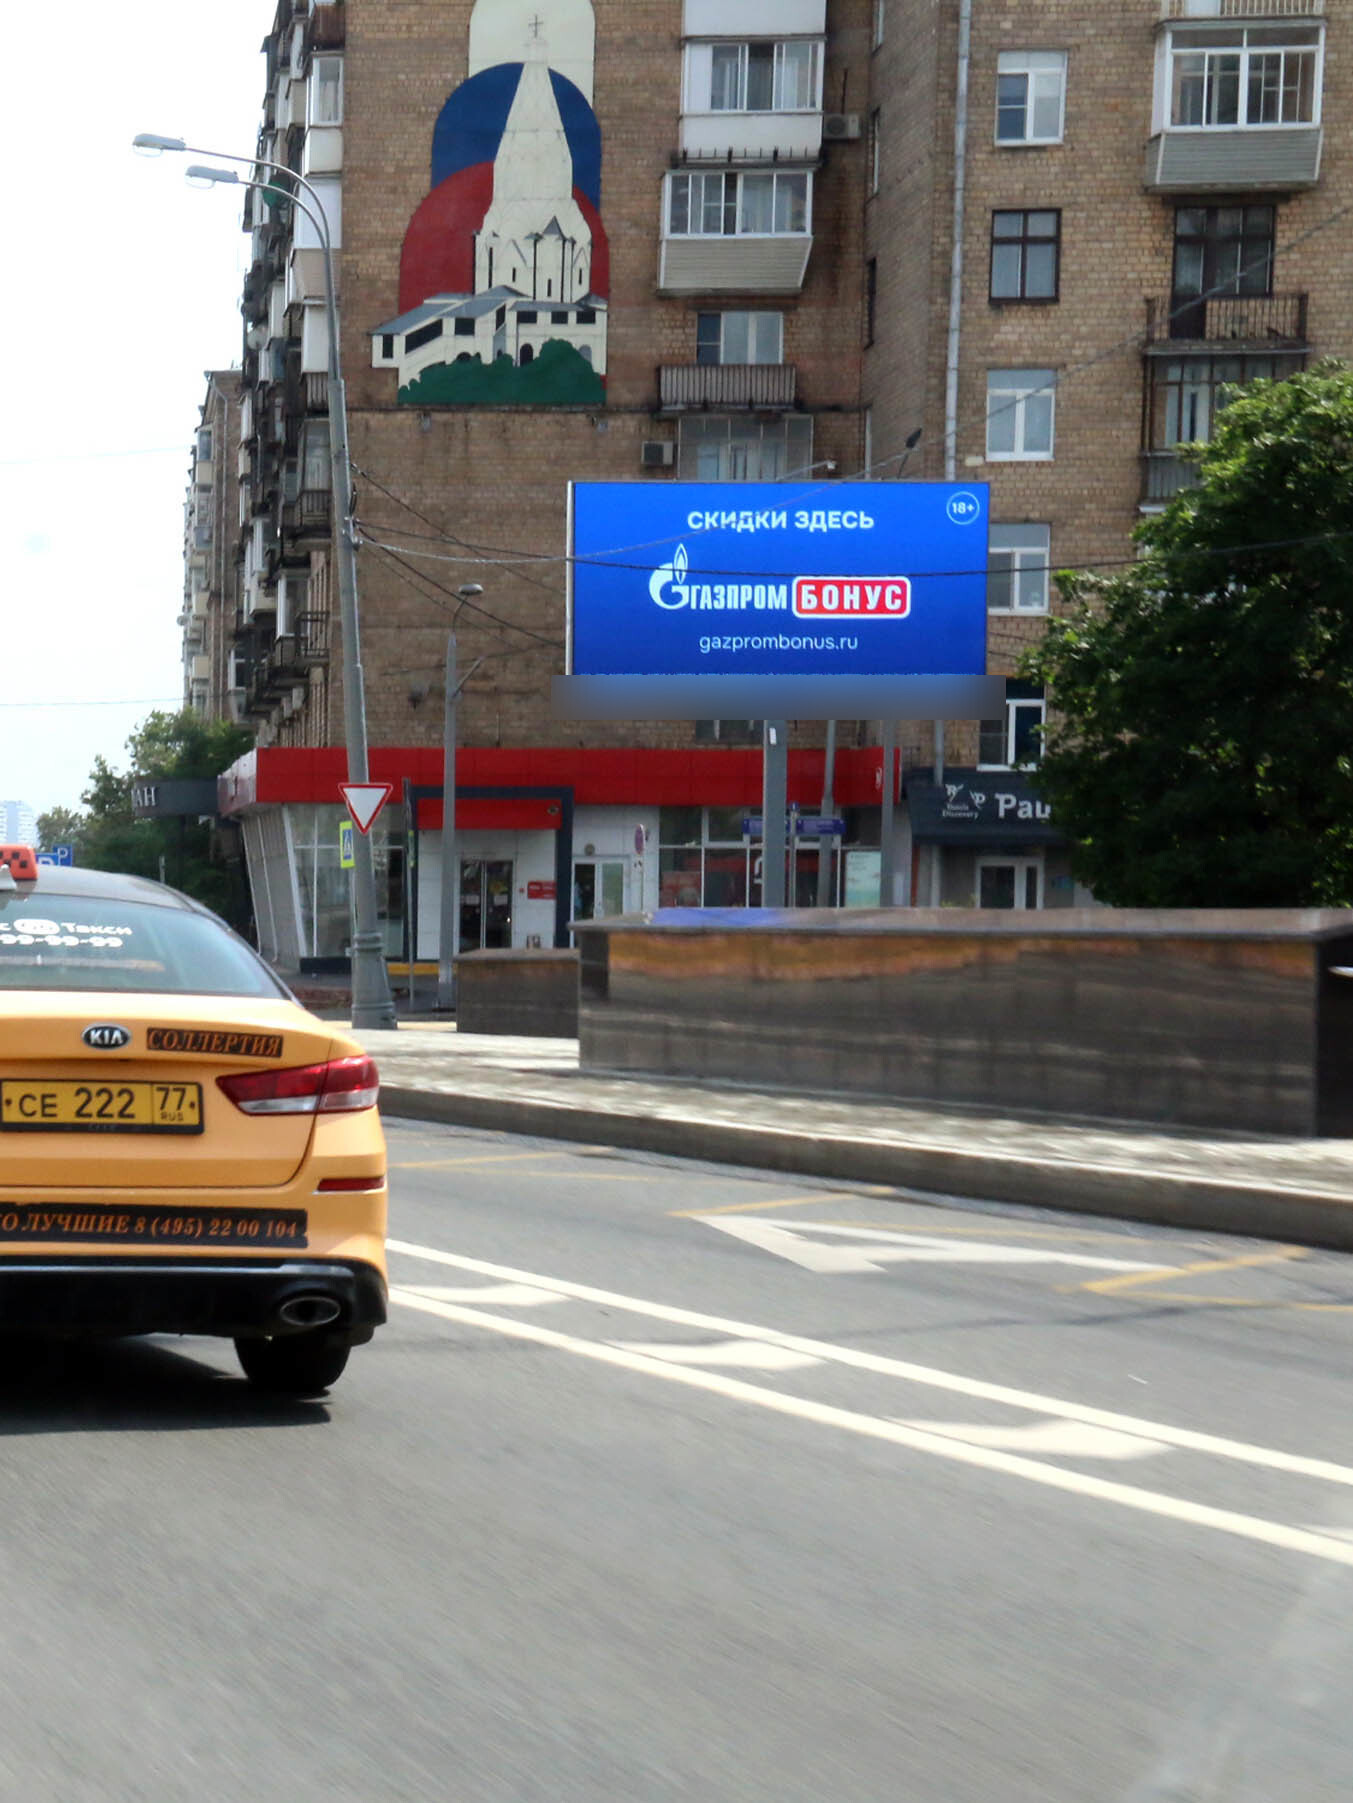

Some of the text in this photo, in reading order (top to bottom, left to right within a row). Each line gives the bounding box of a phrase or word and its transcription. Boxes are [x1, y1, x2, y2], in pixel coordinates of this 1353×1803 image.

[952, 501, 975, 514] 18+
[687, 511, 874, 532] СКИДКИ ЗДЕСЬ
[690, 584, 902, 611] ГАЗПРОМ БОНУС
[699, 633, 859, 654] gazprombonus.ru
[90, 1029, 123, 1045] KIA
[148, 1030, 281, 1057] СОЛЛЕРТИЯ
[74, 1087, 135, 1119] 222
[155, 1087, 187, 1111] 77
[160, 1111, 184, 1122] RUS
[21, 1212, 130, 1234] ЛУЧШИЕ
[134, 1216, 145, 1234] 8
[150, 1216, 204, 1239] (495)
[208, 1218, 231, 1237] 22
[236, 1219, 259, 1238] 00
[265, 1219, 298, 1238] 104
